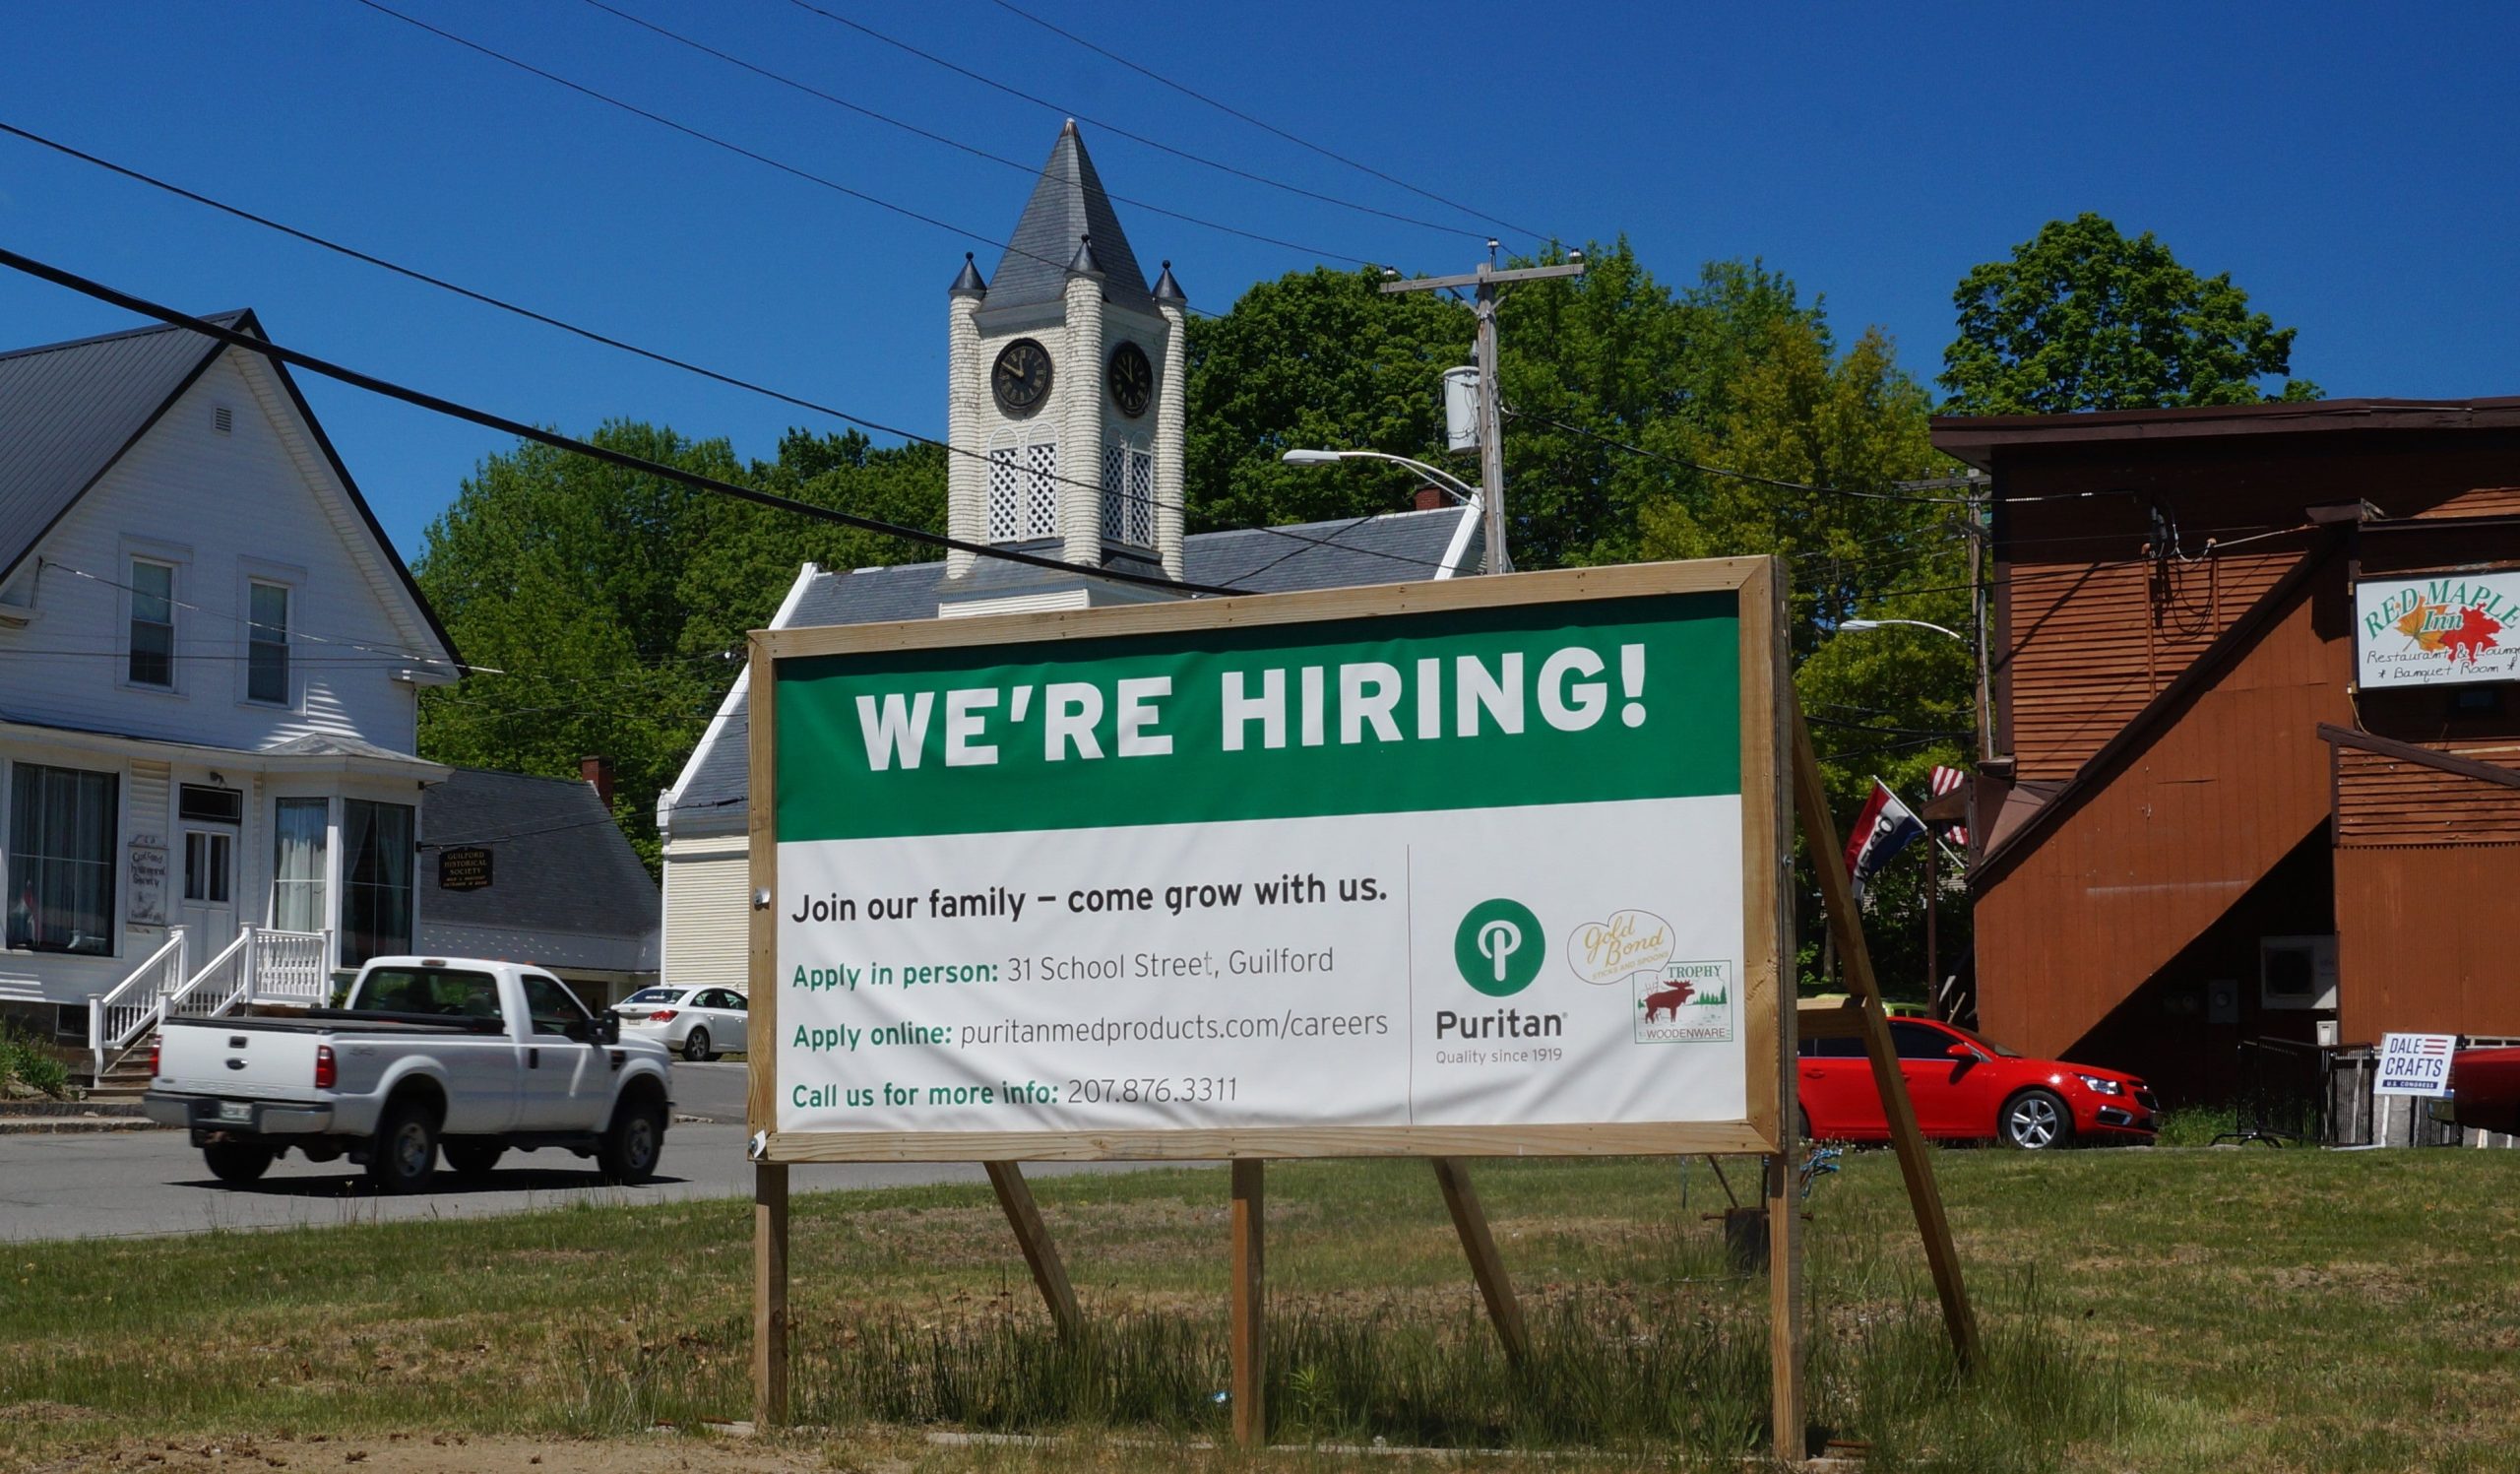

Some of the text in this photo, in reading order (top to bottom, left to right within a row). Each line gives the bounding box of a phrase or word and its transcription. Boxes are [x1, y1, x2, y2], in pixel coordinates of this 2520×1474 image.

[2363, 579, 2520, 640] RED MAPLE
[2422, 610, 2463, 631] Inn
[2366, 643, 2520, 665] Restaurant & Loung
[2393, 661, 2499, 682] Banquet Room
[855, 643, 1647, 771] WE'RE HIRING!
[444, 859, 488, 867] HISTORICAL
[447, 851, 485, 860] GUILFORD
[450, 866, 481, 875] SOCIETY
[791, 891, 856, 924] Join
[867, 896, 919, 922] our
[928, 885, 1027, 924] family
[1068, 886, 1155, 914] come
[1165, 882, 1243, 917] grow
[1253, 871, 1326, 906] with
[1339, 876, 1388, 903] us.
[1605, 925, 1665, 968] Bond
[791, 945, 1334, 993] Apply in person: 31 School Street, Guilford
[1667, 964, 1723, 979] TROPHY
[792, 1008, 1390, 1053] Apply online: puritanmedproducts.com/careers
[1436, 1008, 1563, 1041] Puritan
[1646, 1027, 1727, 1040] WOODENWARE
[1435, 1047, 1563, 1065] Quality since 1919
[2389, 1037, 2423, 1055] DALE
[2384, 1057, 2443, 1077] CRAFTS
[791, 1076, 1237, 1109] Call us for more info: 207.876.3311
